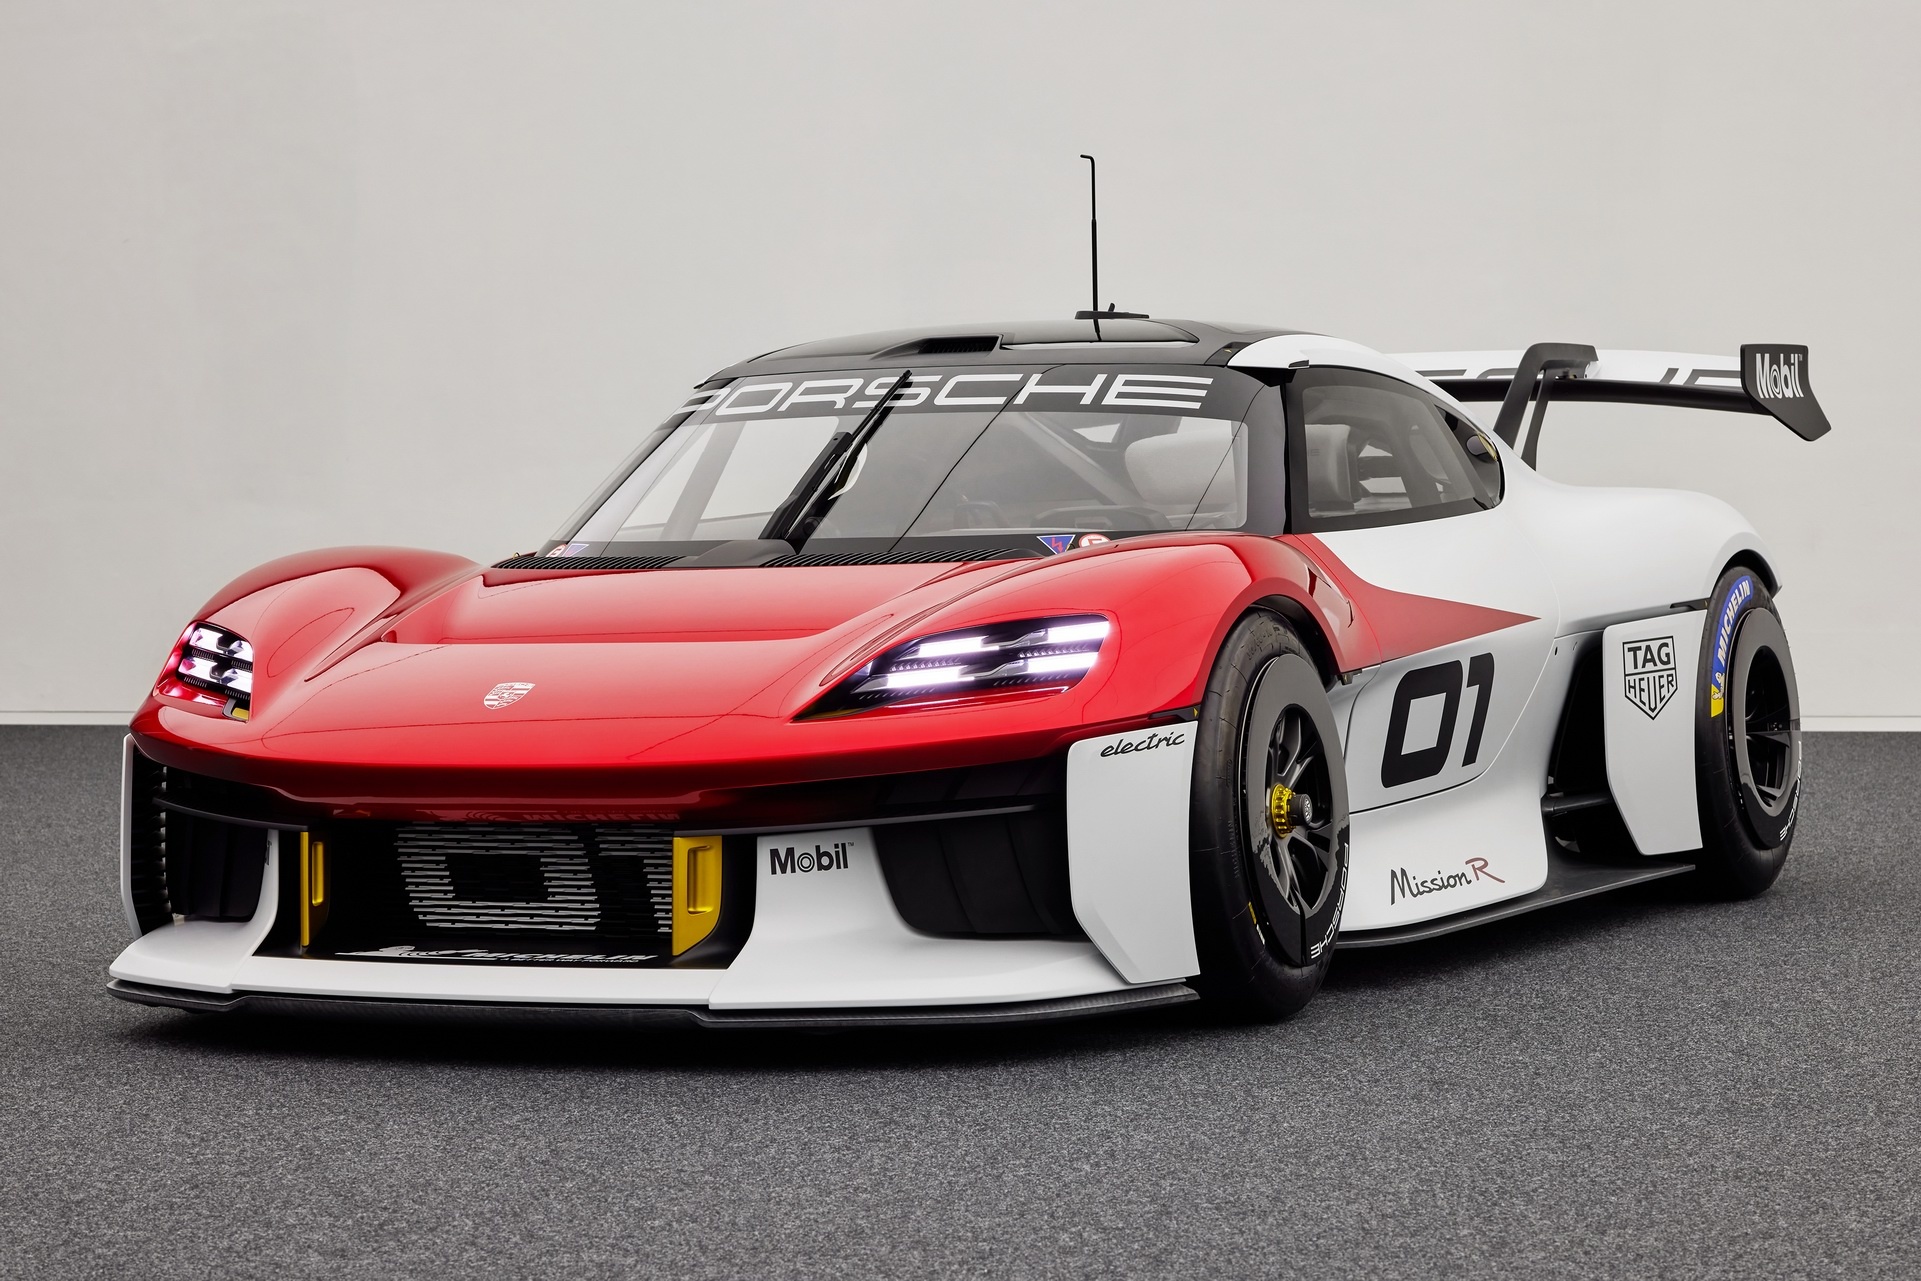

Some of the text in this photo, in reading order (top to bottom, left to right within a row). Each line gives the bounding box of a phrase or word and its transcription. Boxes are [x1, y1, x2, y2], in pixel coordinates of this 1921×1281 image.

[662, 373, 1214, 424] PORSCHE
[1717, 580, 1751, 667] MICHELIN
[1627, 642, 1671, 670] TAG
[1628, 673, 1675, 713] HEUER
[1100, 731, 1186, 758] electric
[1381, 652, 1495, 788] 01
[1390, 857, 1505, 906] Mission R
